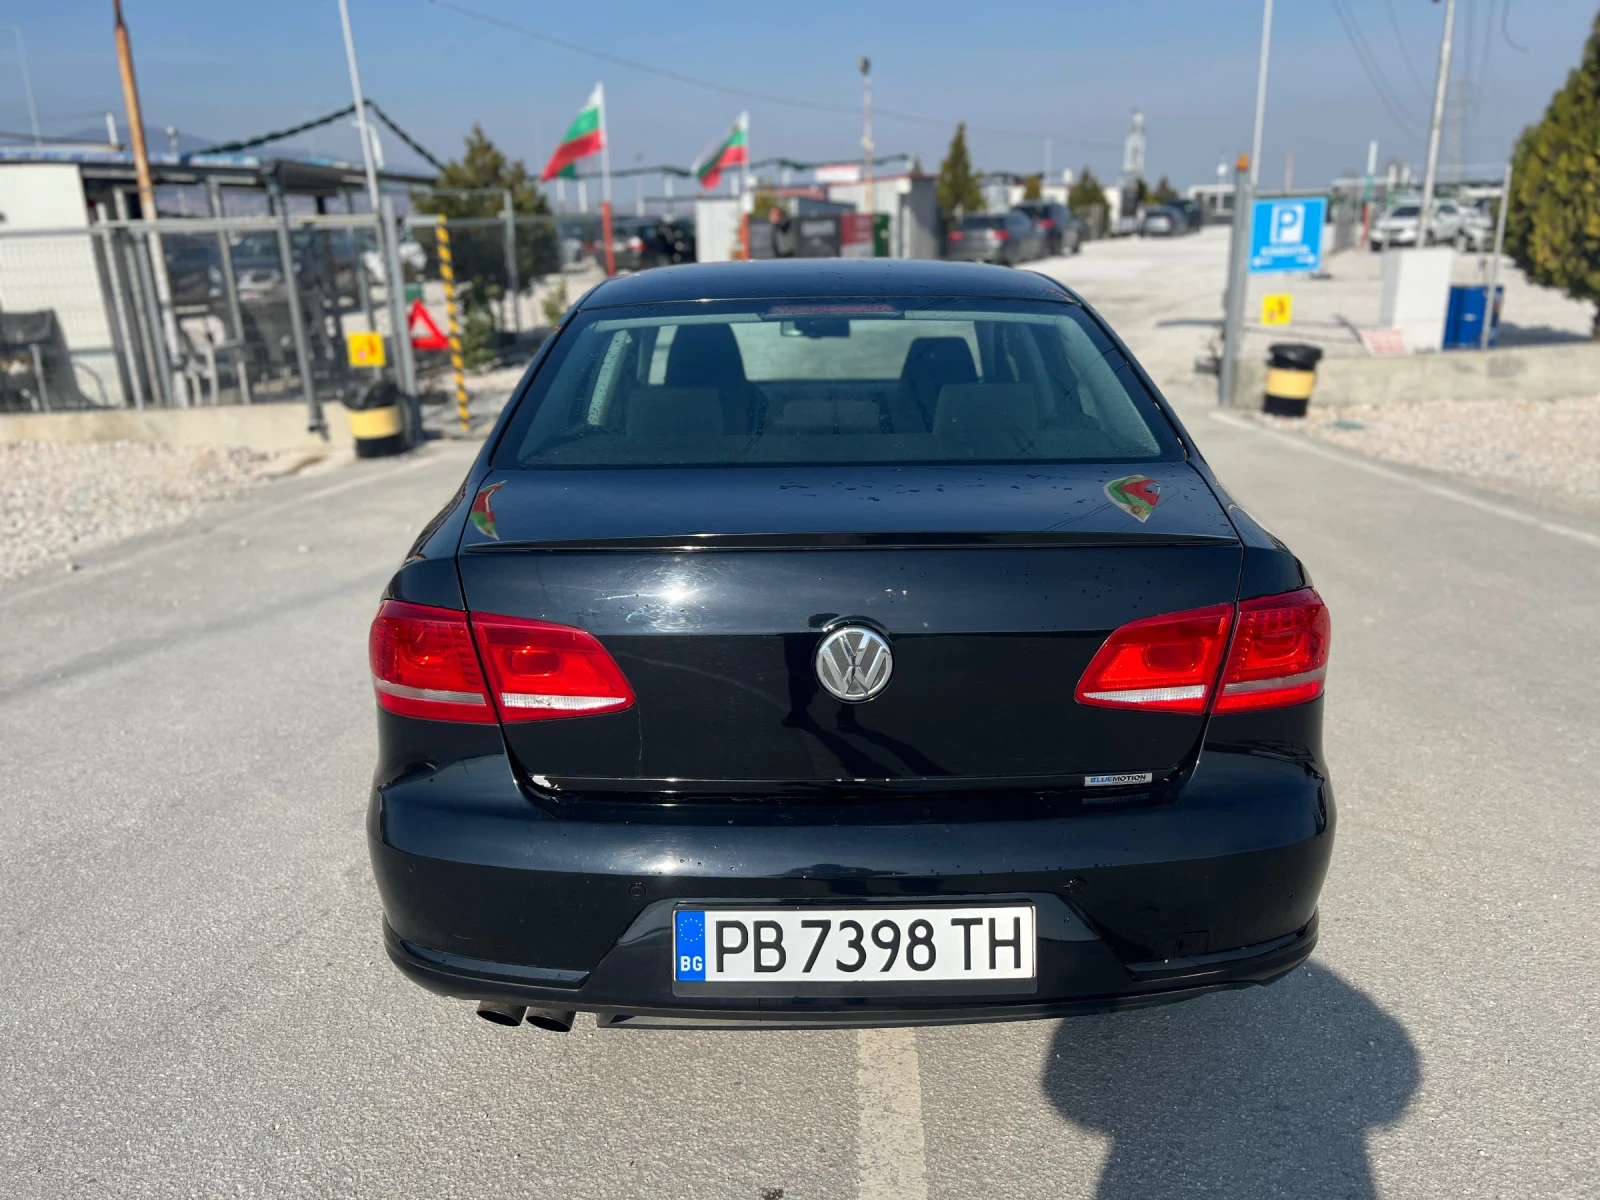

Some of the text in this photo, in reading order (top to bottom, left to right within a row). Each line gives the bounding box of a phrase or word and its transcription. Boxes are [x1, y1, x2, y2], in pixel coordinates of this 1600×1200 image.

[1277, 208, 1298, 239] P
[816, 627, 892, 700] VW
[1090, 775, 1146, 783] BLUEMOTION
[715, 916, 1022, 972] PB 7398 TH
[680, 956, 703, 971] BG
